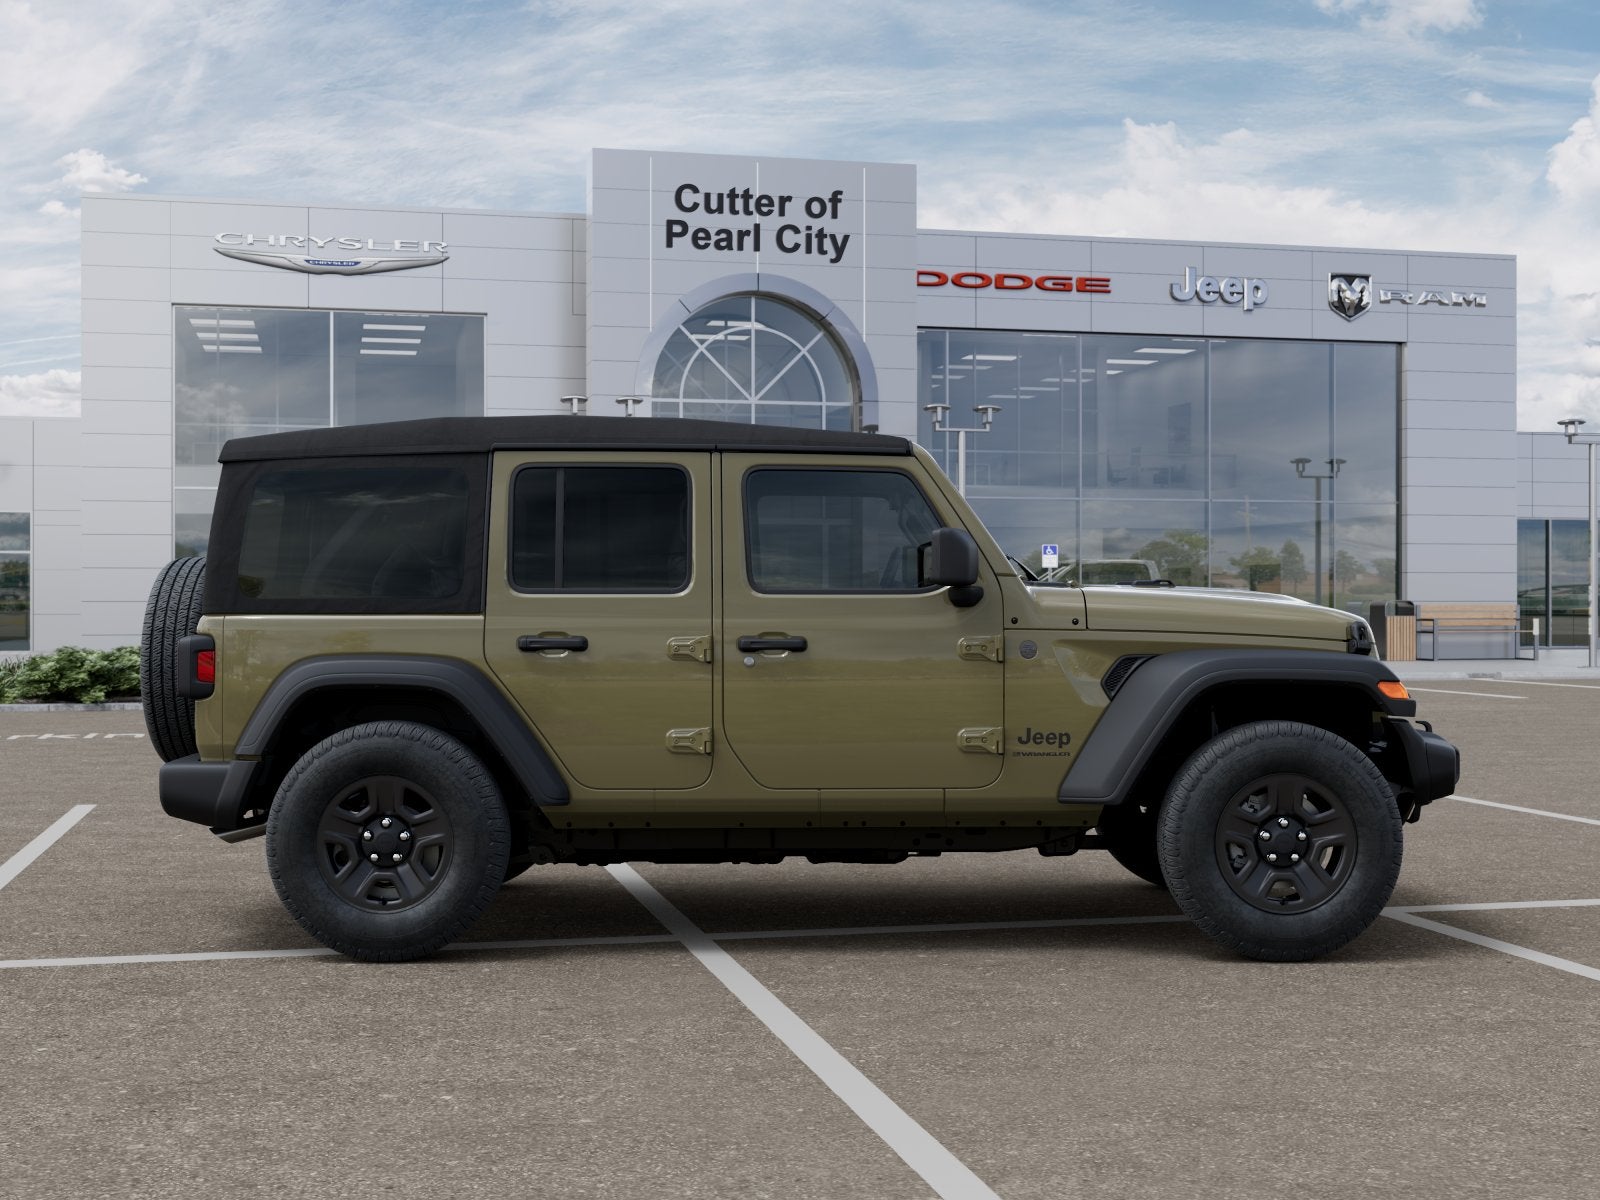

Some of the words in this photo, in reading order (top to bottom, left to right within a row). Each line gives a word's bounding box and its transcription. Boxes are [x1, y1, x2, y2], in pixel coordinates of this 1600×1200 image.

[674, 183, 793, 217] Cutter
[804, 190, 843, 219] of
[214, 232, 449, 253] CHRYSLER
[665, 219, 761, 252] Pearl
[775, 223, 850, 264] City
[916, 270, 1112, 294] DODGE
[1169, 265, 1269, 311] Jeep
[1379, 288, 1488, 308] RAM
[1017, 727, 1071, 749] Jeep
